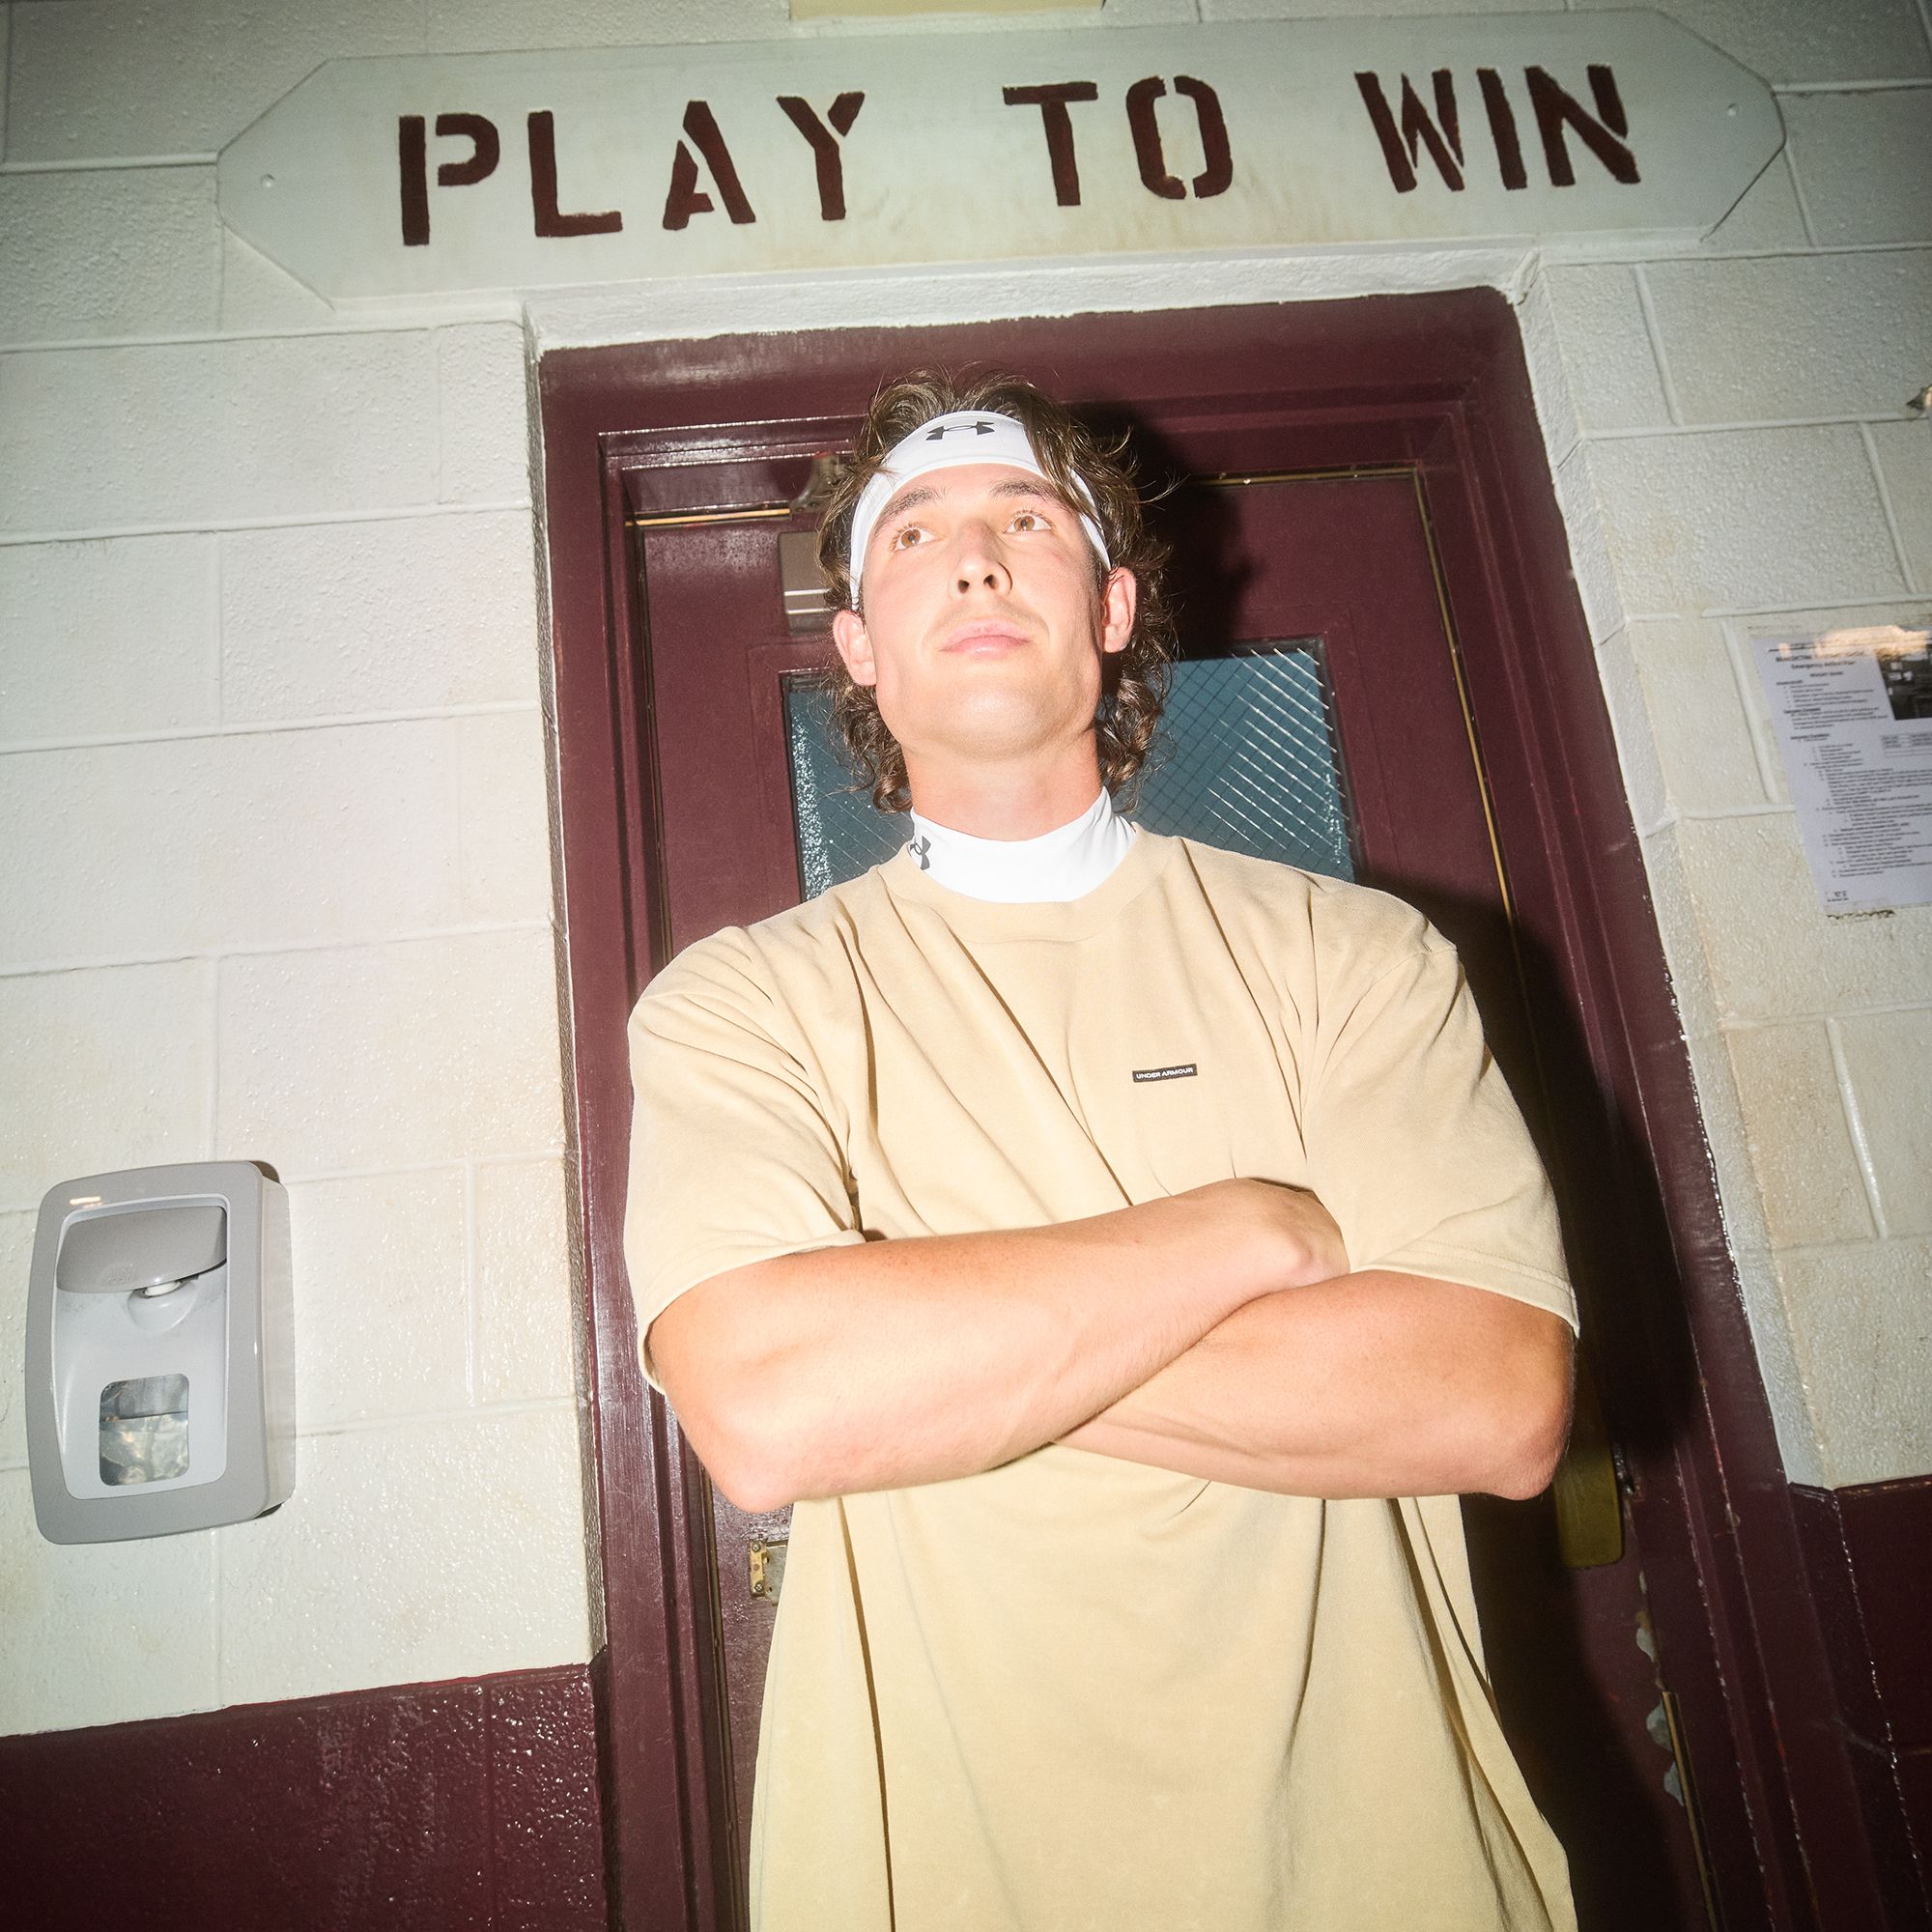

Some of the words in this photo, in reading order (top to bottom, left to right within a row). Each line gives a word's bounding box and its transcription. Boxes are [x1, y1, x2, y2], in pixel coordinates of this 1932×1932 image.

[398, 91, 866, 247] PLAY
[1002, 74, 1234, 207] TO
[1353, 65, 1642, 194] WIN
[1161, 1066, 1193, 1076] ARMOUR
